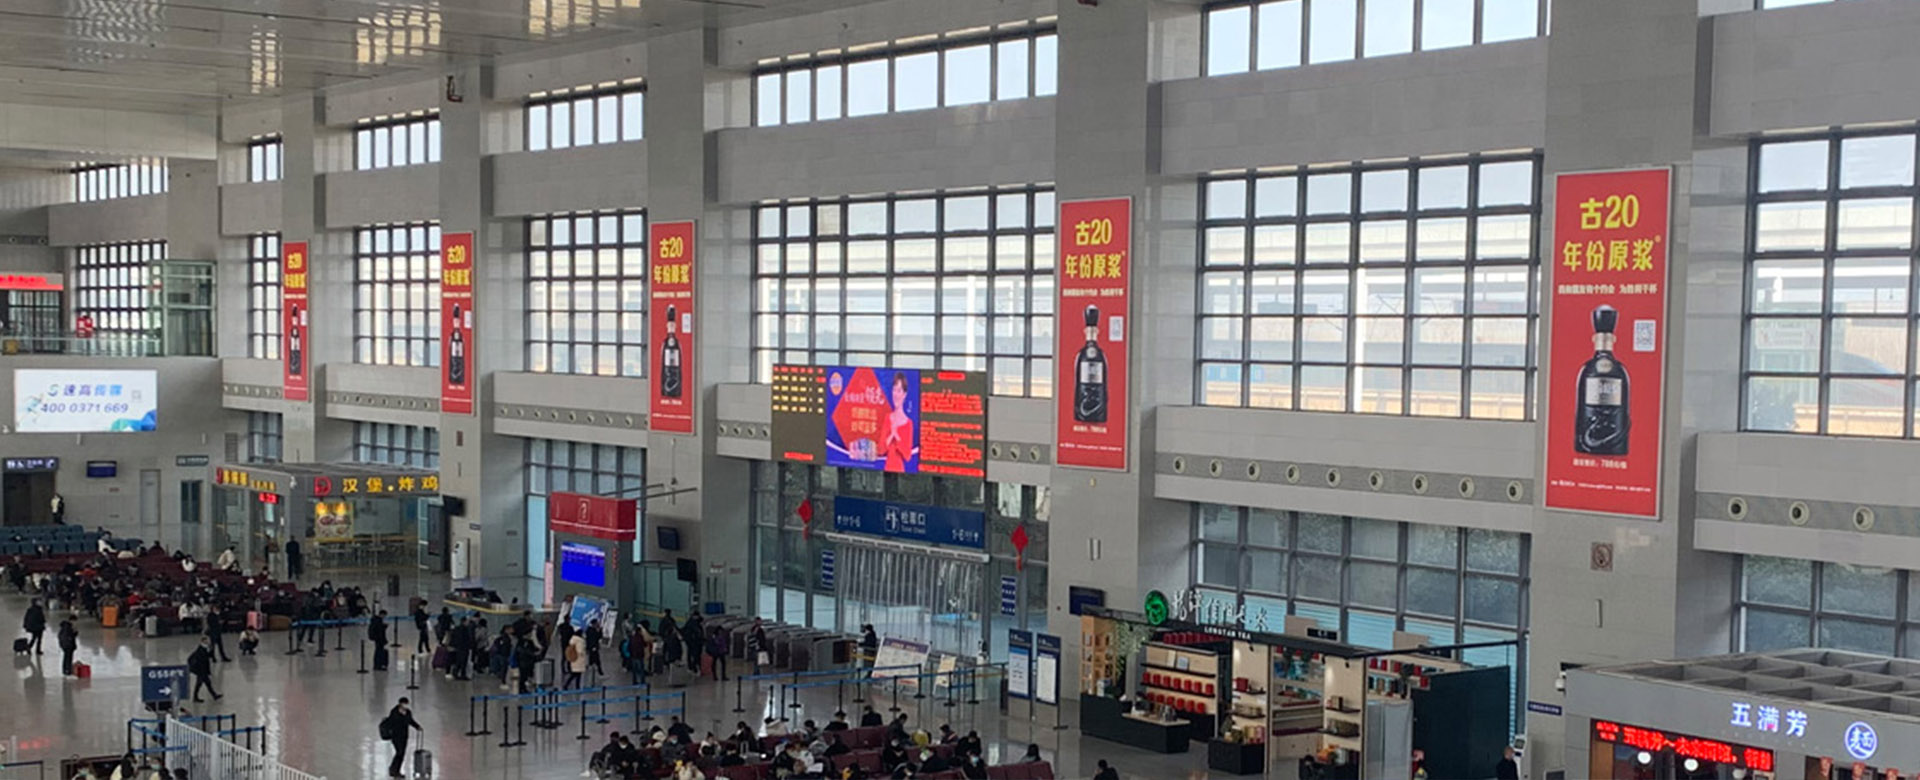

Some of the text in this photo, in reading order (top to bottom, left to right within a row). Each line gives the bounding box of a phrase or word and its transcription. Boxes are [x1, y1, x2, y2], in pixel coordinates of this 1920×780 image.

[1579, 194, 1640, 229] 古20
[1075, 218, 1113, 246] 古20
[659, 236, 683, 259] 古20
[1562, 238, 1654, 272] 年份原浆
[1065, 253, 1122, 279] 年份原浆
[40, 403, 129, 413] 400 0371 669
[900, 511, 926, 525] 检票口
[1730, 702, 1808, 738] 五满芳
